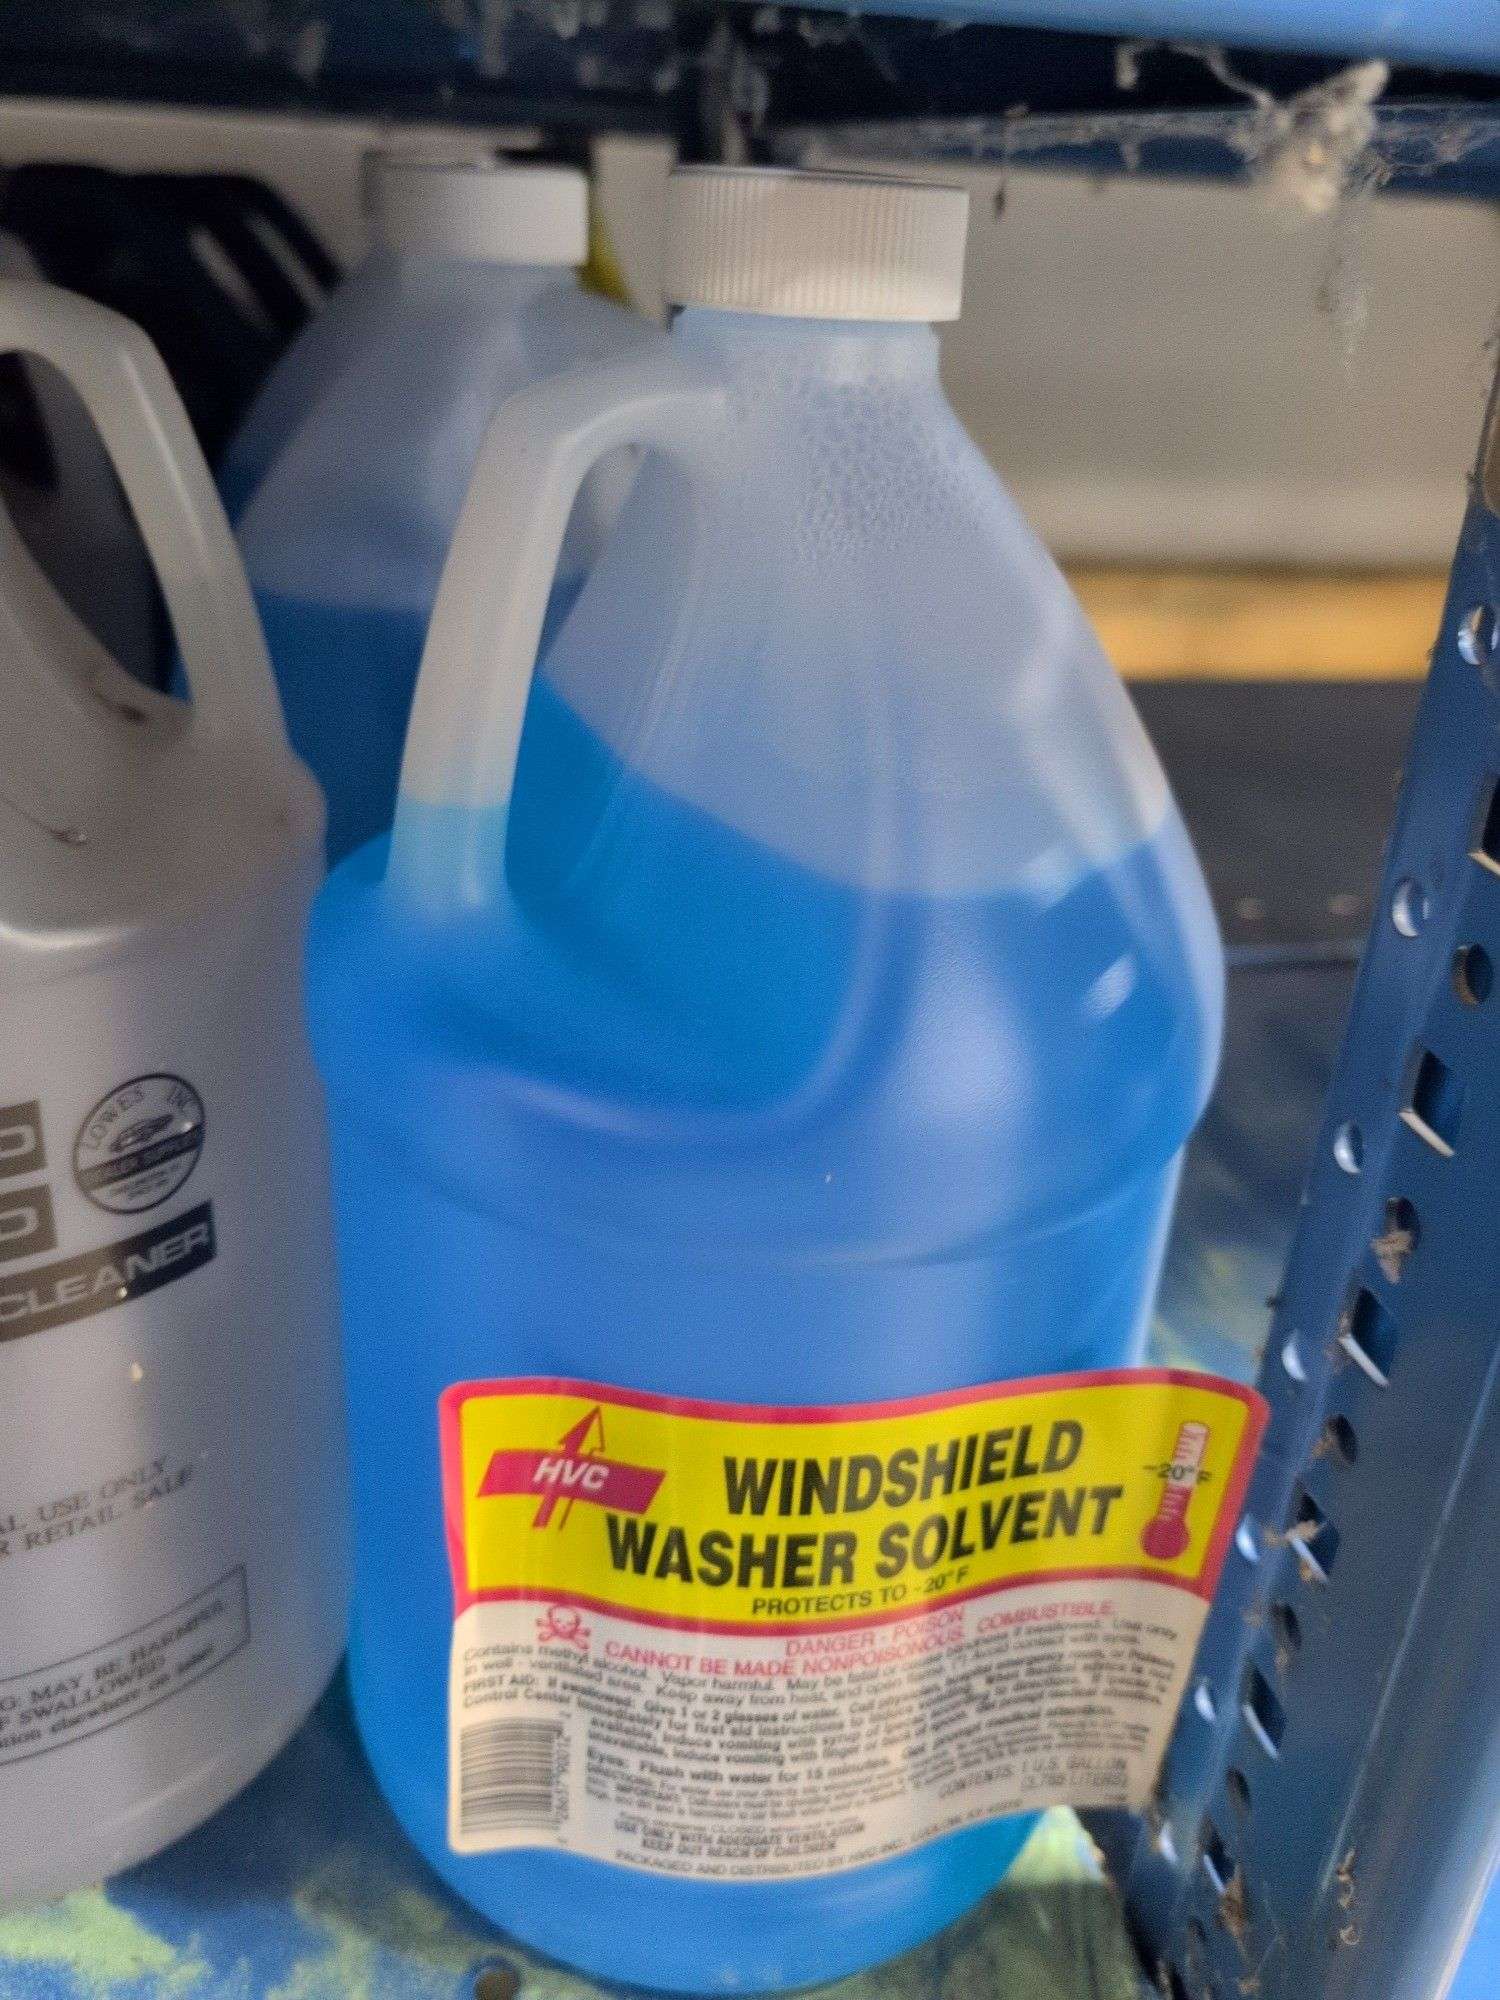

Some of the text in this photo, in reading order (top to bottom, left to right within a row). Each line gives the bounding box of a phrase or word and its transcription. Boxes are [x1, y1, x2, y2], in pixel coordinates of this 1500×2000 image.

[0, 1221, 209, 1322] CLEANER
[39, 1491, 92, 1522] USE
[100, 1454, 168, 1500] ONLY
[532, 1457, 608, 1490] HVC
[723, 1419, 1084, 1516] WINDSHIELD
[25, 1503, 124, 1551] RETAIL
[132, 1461, 195, 1510] SALE
[606, 1484, 1124, 1588] WASHER SOLVENT
[751, 1592, 873, 1616] PROTECTS
[880, 1585, 907, 1602] TO
[785, 1631, 875, 1657] DANGER
[892, 1605, 964, 1643] POISON
[464, 1644, 533, 1661] Contains
[538, 1645, 589, 1664] methyl
[662, 1670, 707, 1687] Vapor
[787, 1677, 818, 1691] May
[824, 1674, 842, 1687] be
[482, 1656, 514, 1671] well
[655, 1685, 697, 1704] Keep
[702, 1693, 745, 1707] away
[750, 1693, 785, 1705] from
[833, 1684, 862, 1701] and
[605, 1641, 694, 1671] CANNOT
[700, 1656, 727, 1676] BE
[733, 1658, 795, 1677] MADE
[19, 1654, 167, 1726] SWALLOWED
[31, 1673, 84, 1704] MAY
[93, 1661, 121, 1682] BE
[463, 1674, 505, 1694] FIRST
[644, 1699, 676, 1716] Give
[681, 1705, 688, 1718] 1
[691, 1709, 708, 1720] or
[711, 1709, 721, 1721] 2
[725, 1710, 779, 1725] glasses
[782, 1708, 797, 1722] of
[464, 1688, 518, 1708] Control
[524, 1687, 571, 1704] Center
[577, 1696, 662, 1730] immediately
[667, 1718, 688, 1731] for
[694, 1721, 725, 1736] first
[730, 1724, 752, 1737] aid
[758, 1721, 845, 1737] instructions
[719, 1739, 780, 1753] vomiting
[786, 1736, 817, 1749] with
[726, 1753, 785, 1767] vomiting
[790, 1750, 818, 1762] with
[640, 1759, 685, 1779] Flush
[689, 1769, 723, 1782] with
[728, 1772, 772, 1785] water
[778, 1768, 799, 1784] for
[806, 1766, 824, 1780] 15
[641, 1837, 674, 1852] KEEP
[677, 1842, 703, 1856] OUT
[706, 1845, 750, 1858] REACH
[753, 1847, 769, 1859] OF
[679, 1830, 714, 1845] WITH
[716, 1834, 782, 1847] ADEQUATE
[710, 1823, 767, 1834] CLOSED
[615, 1849, 692, 1873] PACKAGED
[695, 1862, 728, 1875] AND
[729, 1858, 825, 1876] DISTRIBUTED
